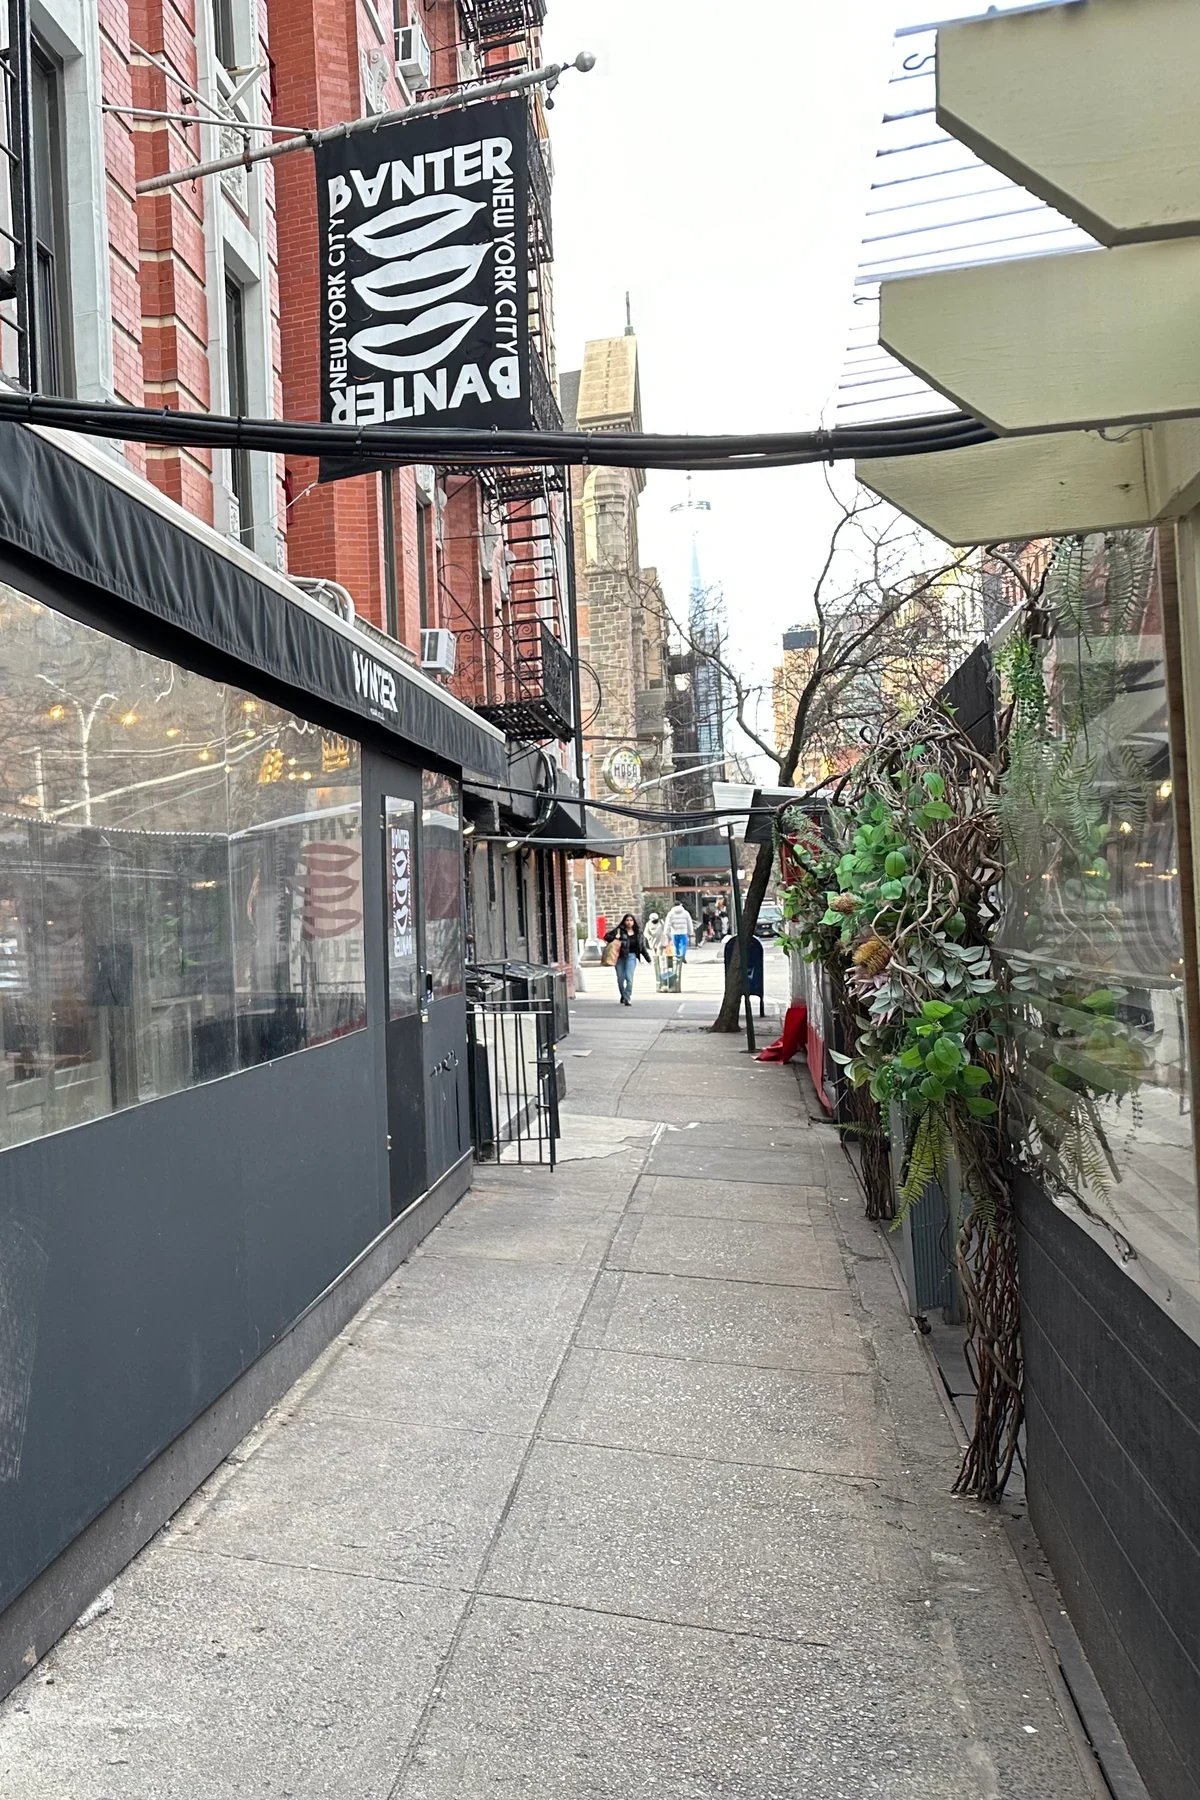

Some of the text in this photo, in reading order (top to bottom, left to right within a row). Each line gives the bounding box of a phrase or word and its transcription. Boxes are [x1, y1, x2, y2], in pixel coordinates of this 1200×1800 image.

[328, 137, 514, 219] BANTER
[327, 218, 348, 389] NEW YORK CITY
[492, 177, 519, 355] NEW YORK CITY
[330, 355, 521, 426] BANTER
